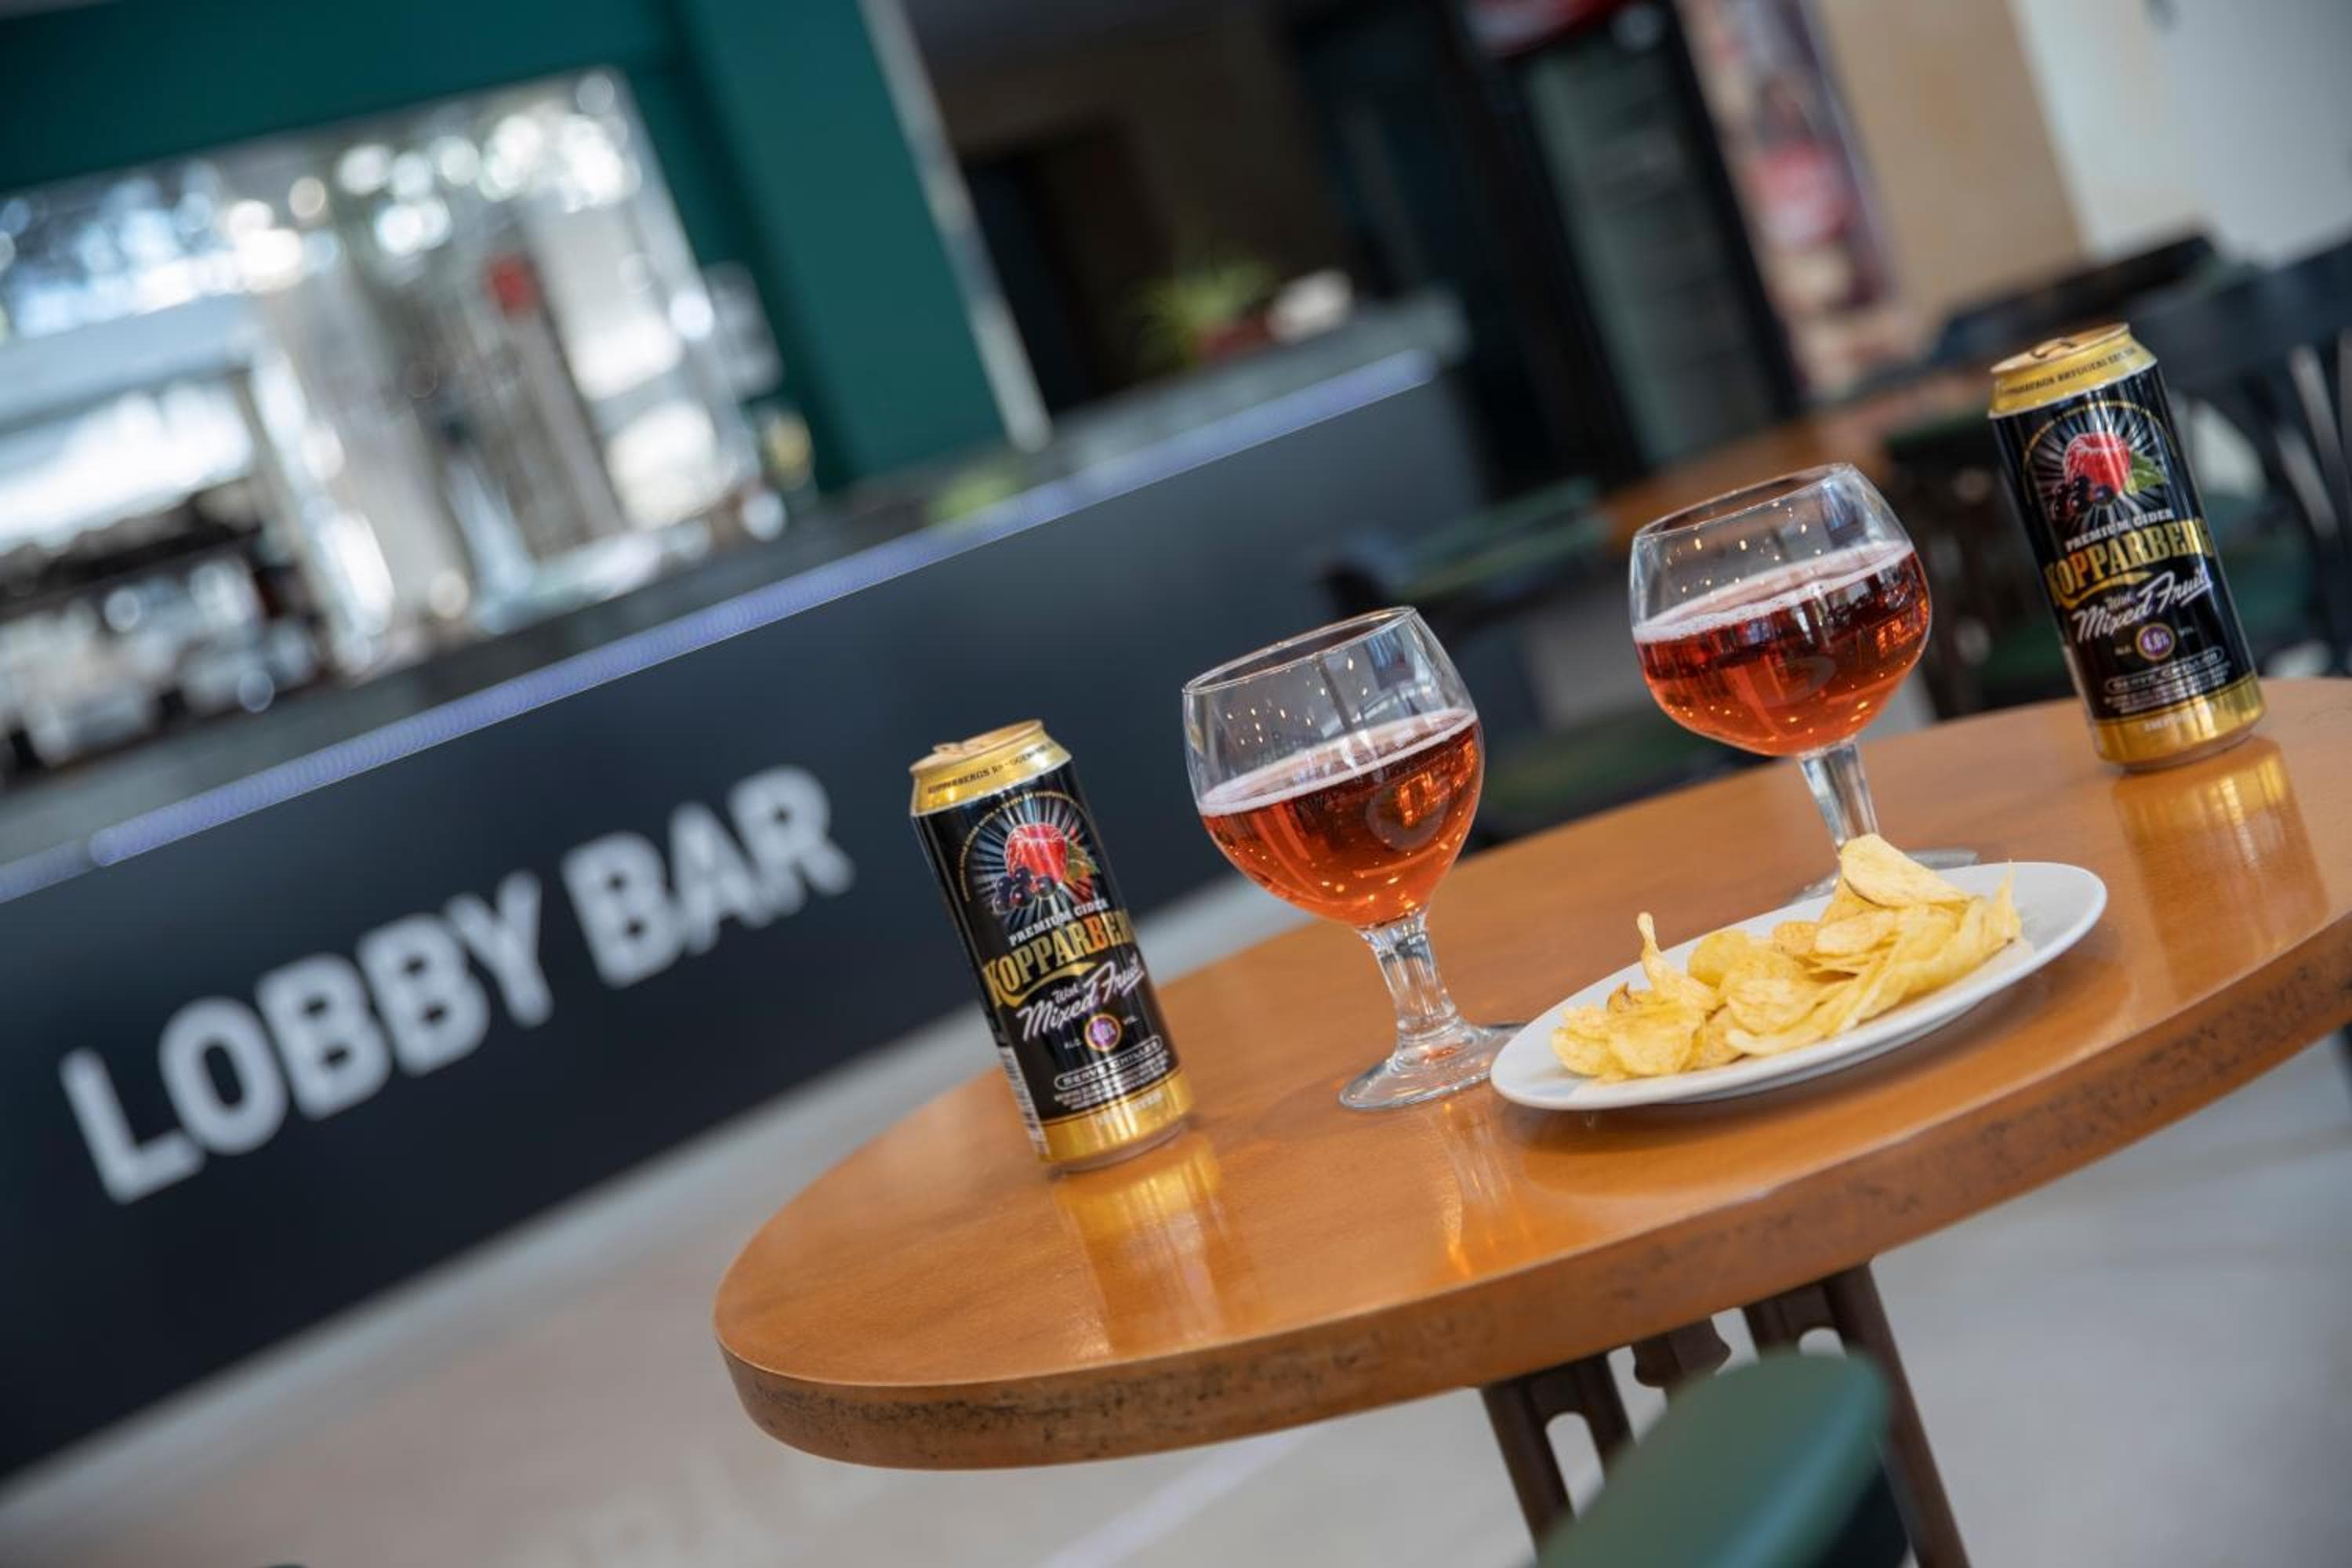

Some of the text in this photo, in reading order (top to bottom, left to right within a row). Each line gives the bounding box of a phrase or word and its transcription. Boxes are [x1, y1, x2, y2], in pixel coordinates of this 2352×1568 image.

[2065, 508, 2176, 552] PREMIUM CIDER
[2072, 567, 2214, 643] Mixed Fruit
[1008, 898, 1109, 947] PREMIUM CIDER
[58, 764, 857, 1206] LOBBY BAR
[1016, 954, 1145, 1041] Mixed Fruit
